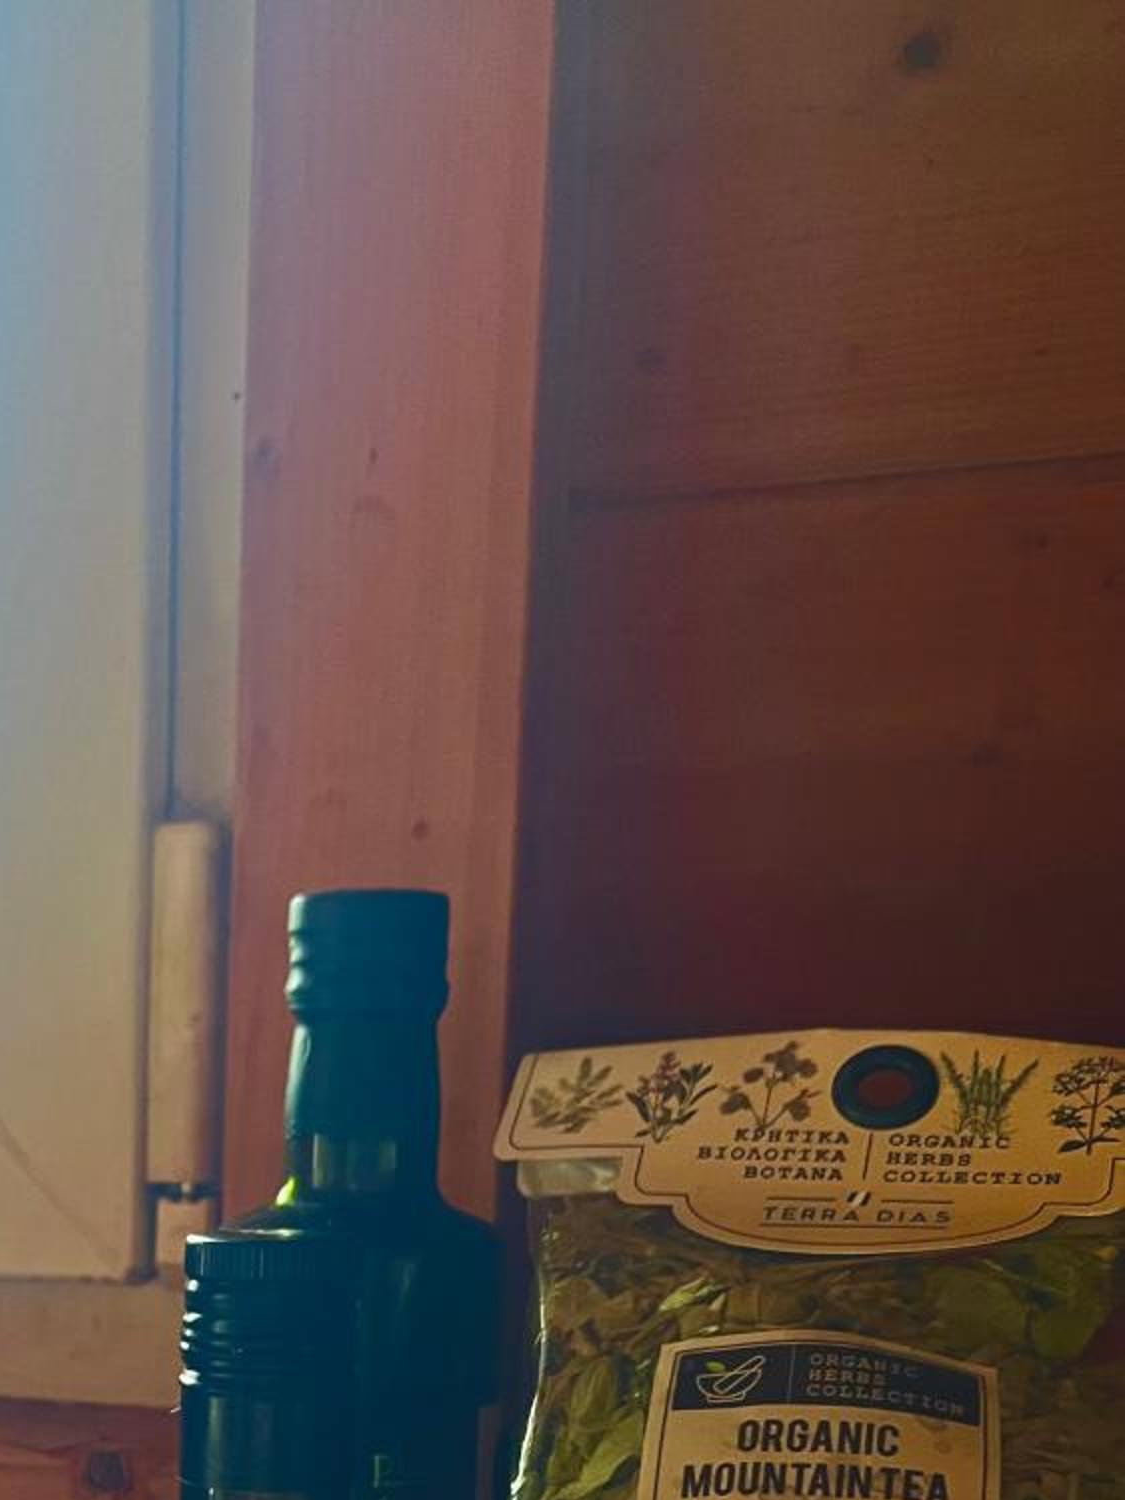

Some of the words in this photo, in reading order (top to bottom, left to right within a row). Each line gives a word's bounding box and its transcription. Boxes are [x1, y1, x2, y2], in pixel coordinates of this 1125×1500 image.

[734, 1128, 850, 1145] ΚΡΗΤΙΚΑ
[887, 1133, 1013, 1150] ORGANIC
[697, 1144, 847, 1163] ΒΙΟΛΟΓΙΚΑ
[885, 1151, 973, 1167] HERBS
[882, 1170, 1064, 1186] COLLECTION
[763, 1206, 861, 1223] TERRA
[876, 1209, 951, 1224] DIAS
[810, 1352, 923, 1378] ORGANIC
[808, 1368, 887, 1387] HERBS
[805, 1383, 964, 1416] COLLECTION
[737, 1418, 900, 1458] ORGANIC
[681, 1463, 874, 1500] MOUNTAIN
